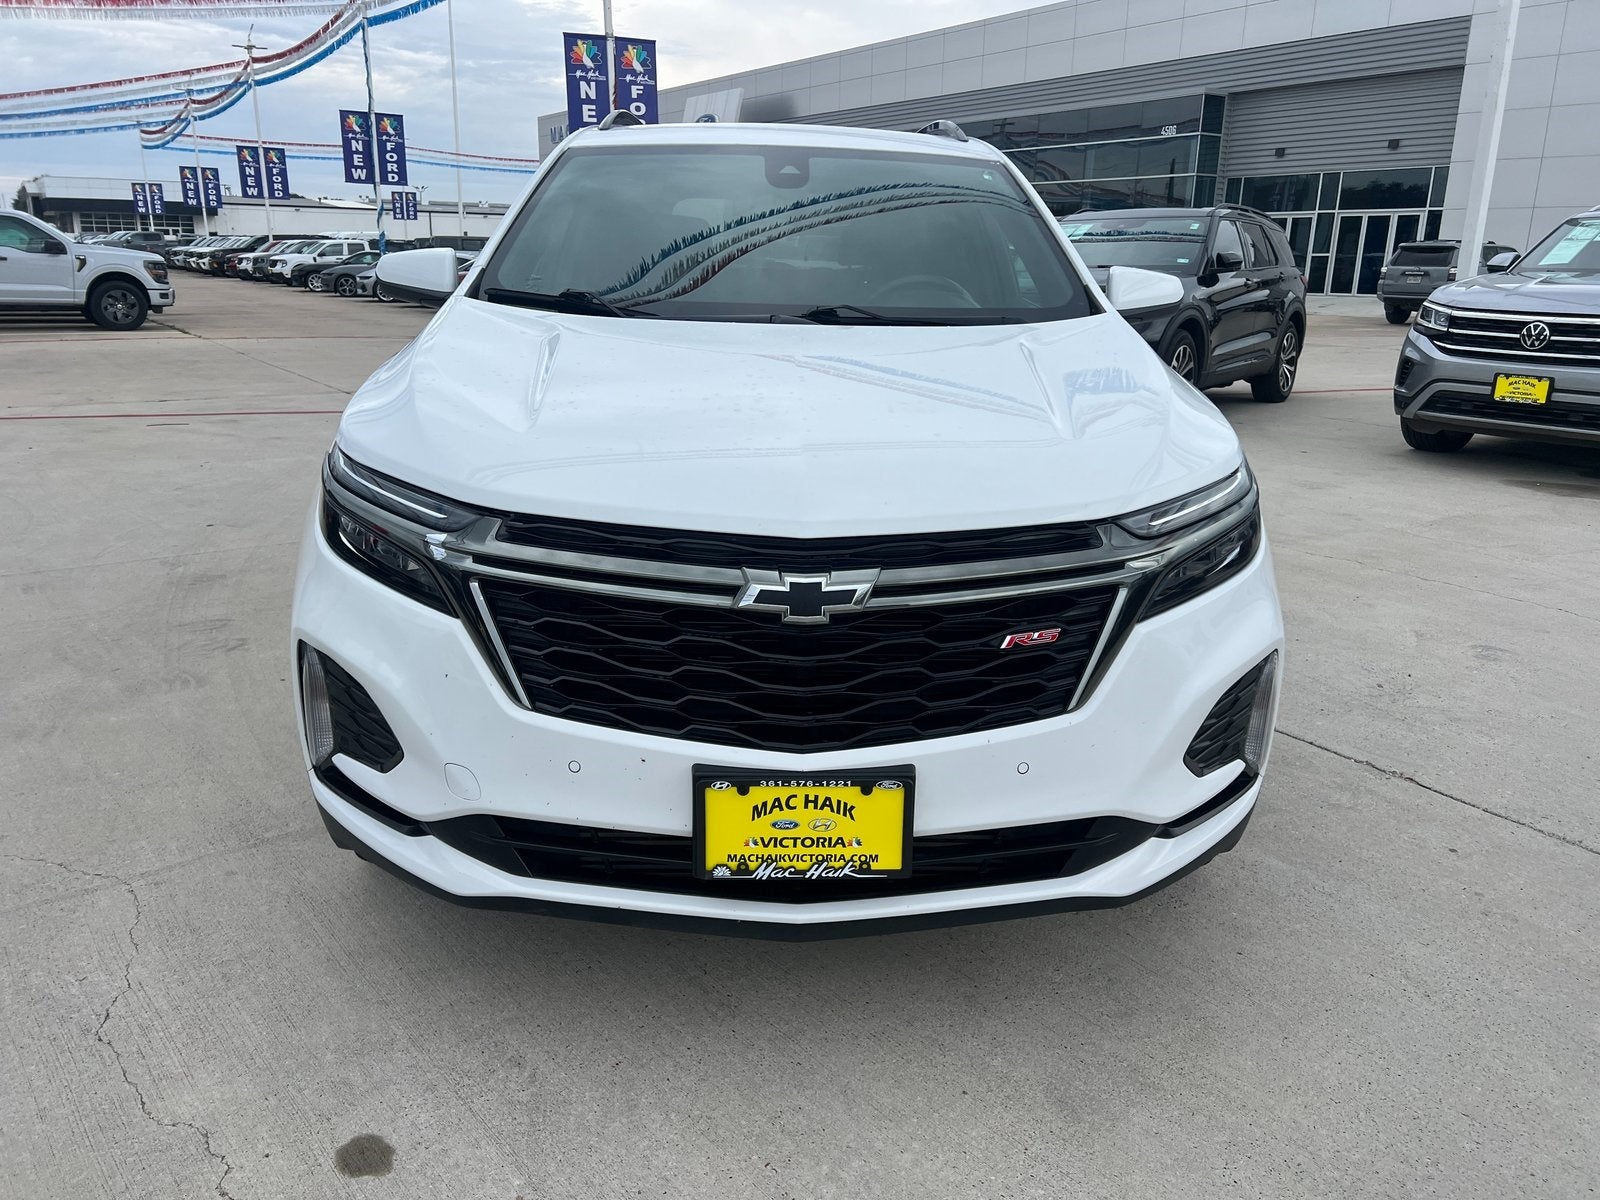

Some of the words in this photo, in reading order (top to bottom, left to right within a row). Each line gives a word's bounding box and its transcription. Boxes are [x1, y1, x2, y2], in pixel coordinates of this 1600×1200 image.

[630, 85, 646, 125] FO
[551, 125, 569, 144] MA
[351, 140, 367, 180] NEW
[385, 142, 399, 182] FORD
[245, 166, 258, 196] NEW
[272, 168, 283, 197] FORD
[136, 194, 146, 213] NEW
[186, 182, 197, 206] NEW
[208, 183, 217, 206] FORD
[154, 195, 162, 214] FORD
[1000, 628, 1061, 648] RS
[878, 781, 900, 789] Ford
[752, 794, 797, 821] MAC
[803, 794, 855, 821] HAIK
[773, 820, 797, 829] Ford
[760, 837, 846, 848] VICTORIA
[727, 854, 879, 863] MACHAIKVICTORIA.COM
[752, 862, 797, 880] Mac
[804, 862, 858, 880] Haik
